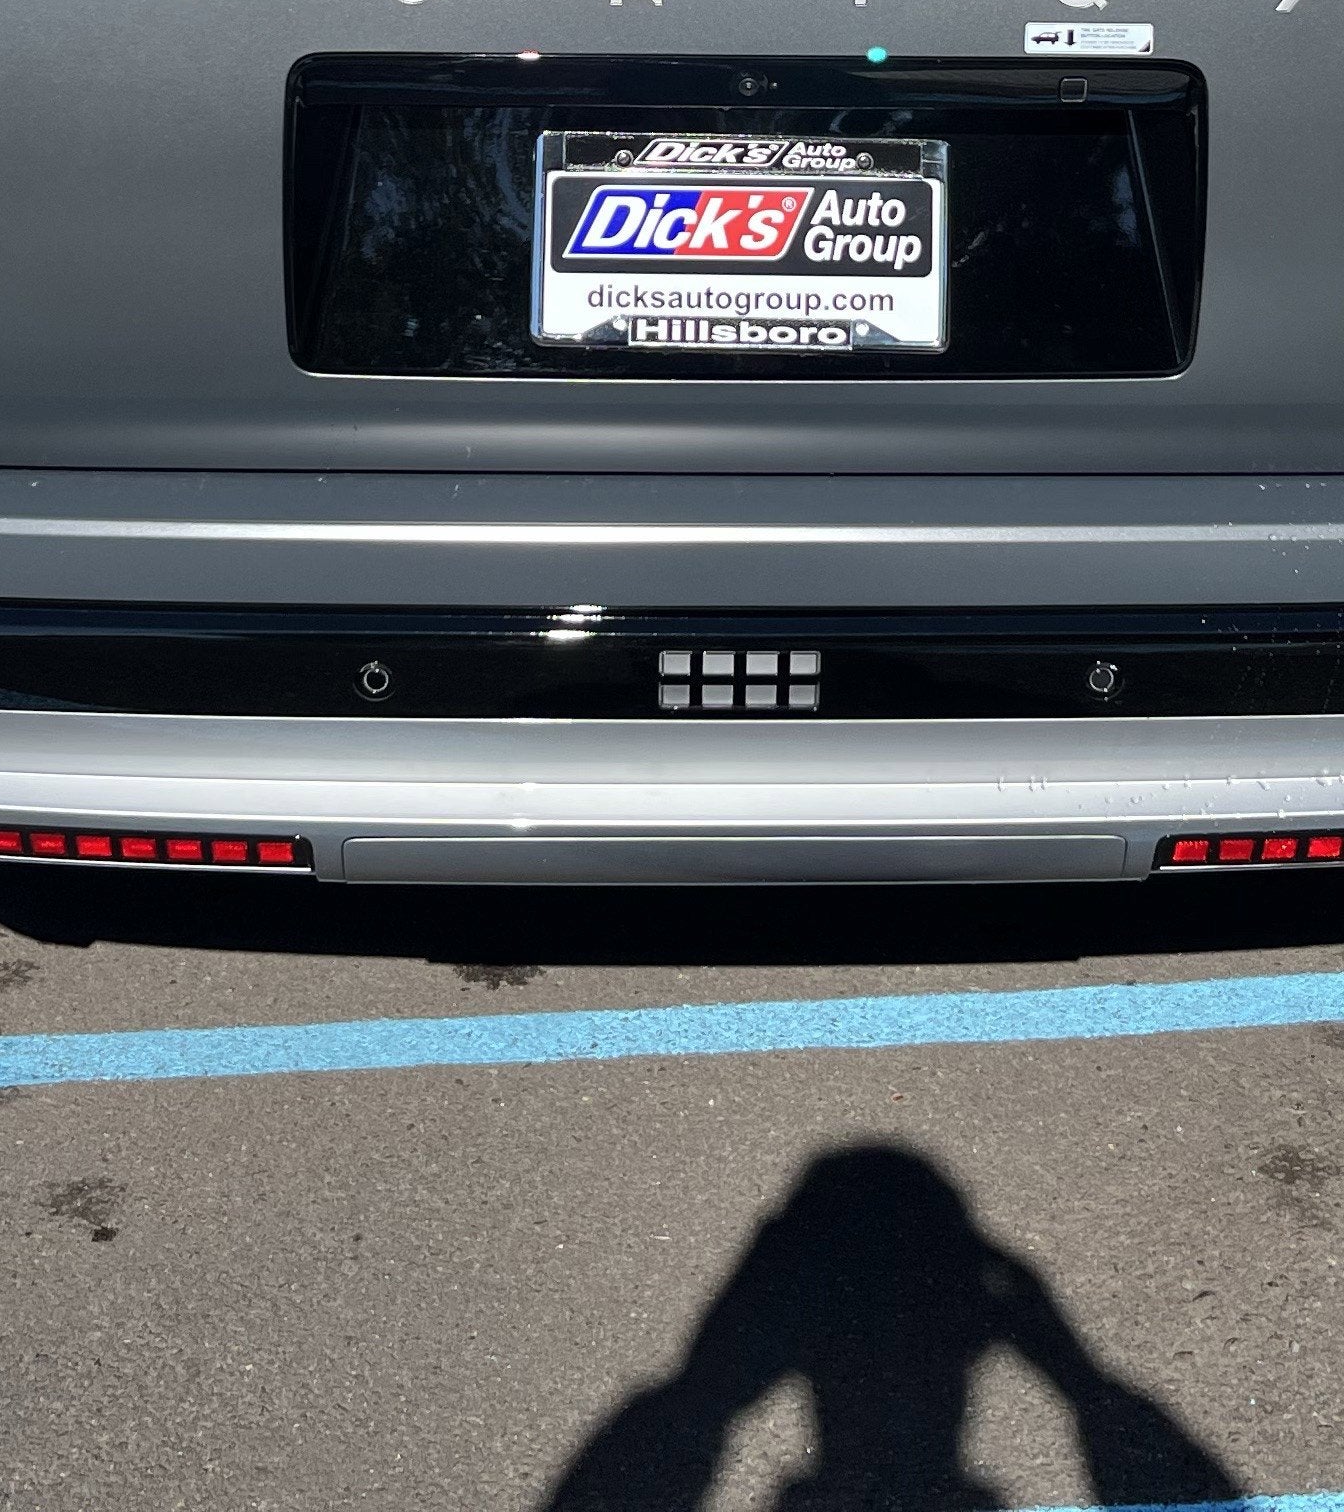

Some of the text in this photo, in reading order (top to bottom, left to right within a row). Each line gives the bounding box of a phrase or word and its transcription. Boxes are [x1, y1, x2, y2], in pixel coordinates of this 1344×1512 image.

[781, 154, 857, 172] Group
[787, 141, 847, 157] Auto
[810, 189, 906, 227] Auto
[804, 224, 922, 271] Group
[587, 284, 895, 316] dicksautogroup.com
[635, 318, 850, 345] Hillsboro
